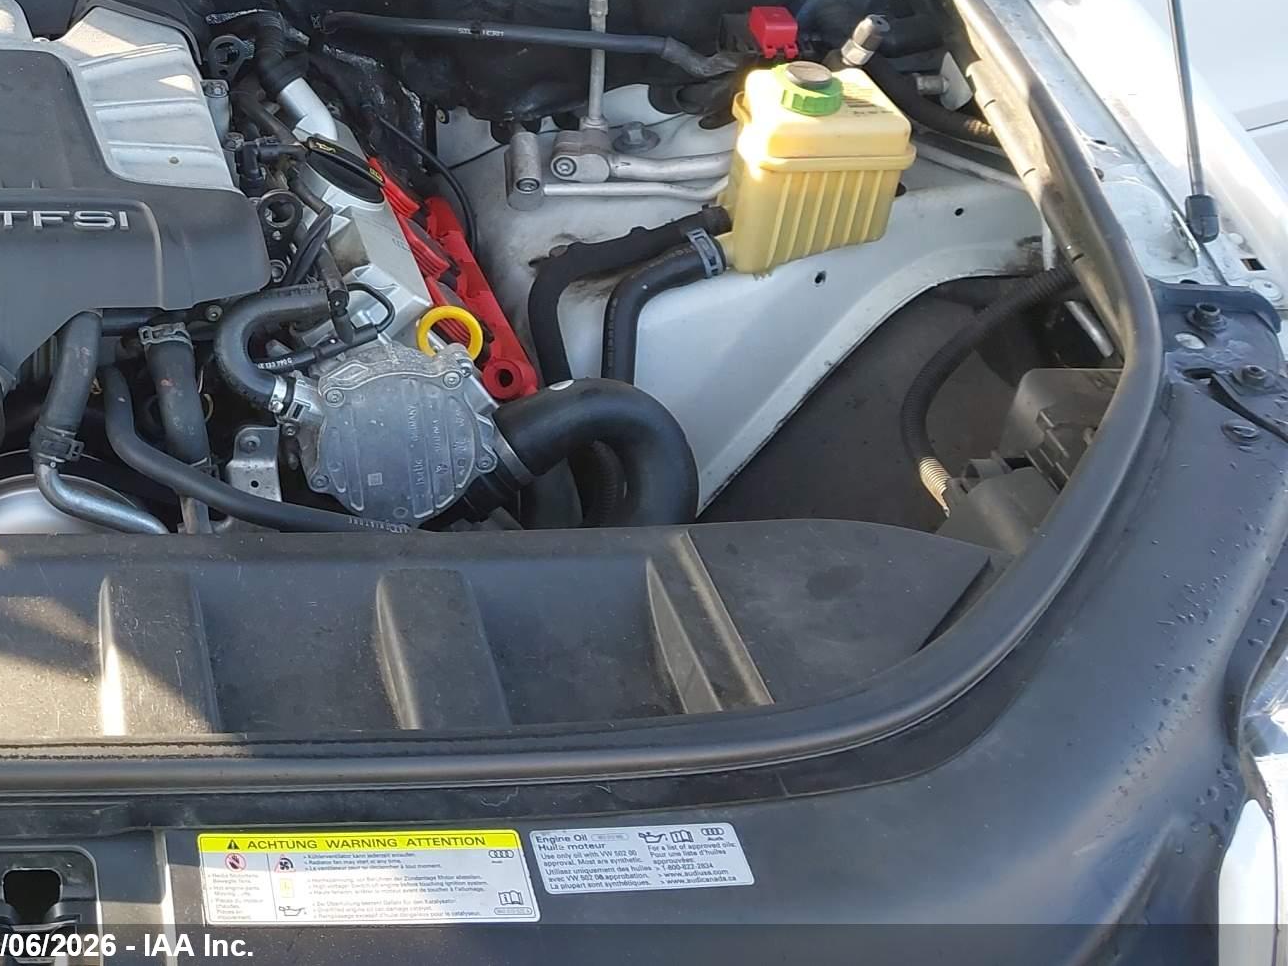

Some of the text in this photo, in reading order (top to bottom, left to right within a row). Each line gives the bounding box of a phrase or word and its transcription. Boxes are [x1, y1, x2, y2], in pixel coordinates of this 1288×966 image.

[247, 836, 486, 850] ACHTUNG WARNING ATTENTION
[536, 835, 570, 845] Engine
[573, 833, 588, 842] Oil
[688, 842, 721, 851] approved
